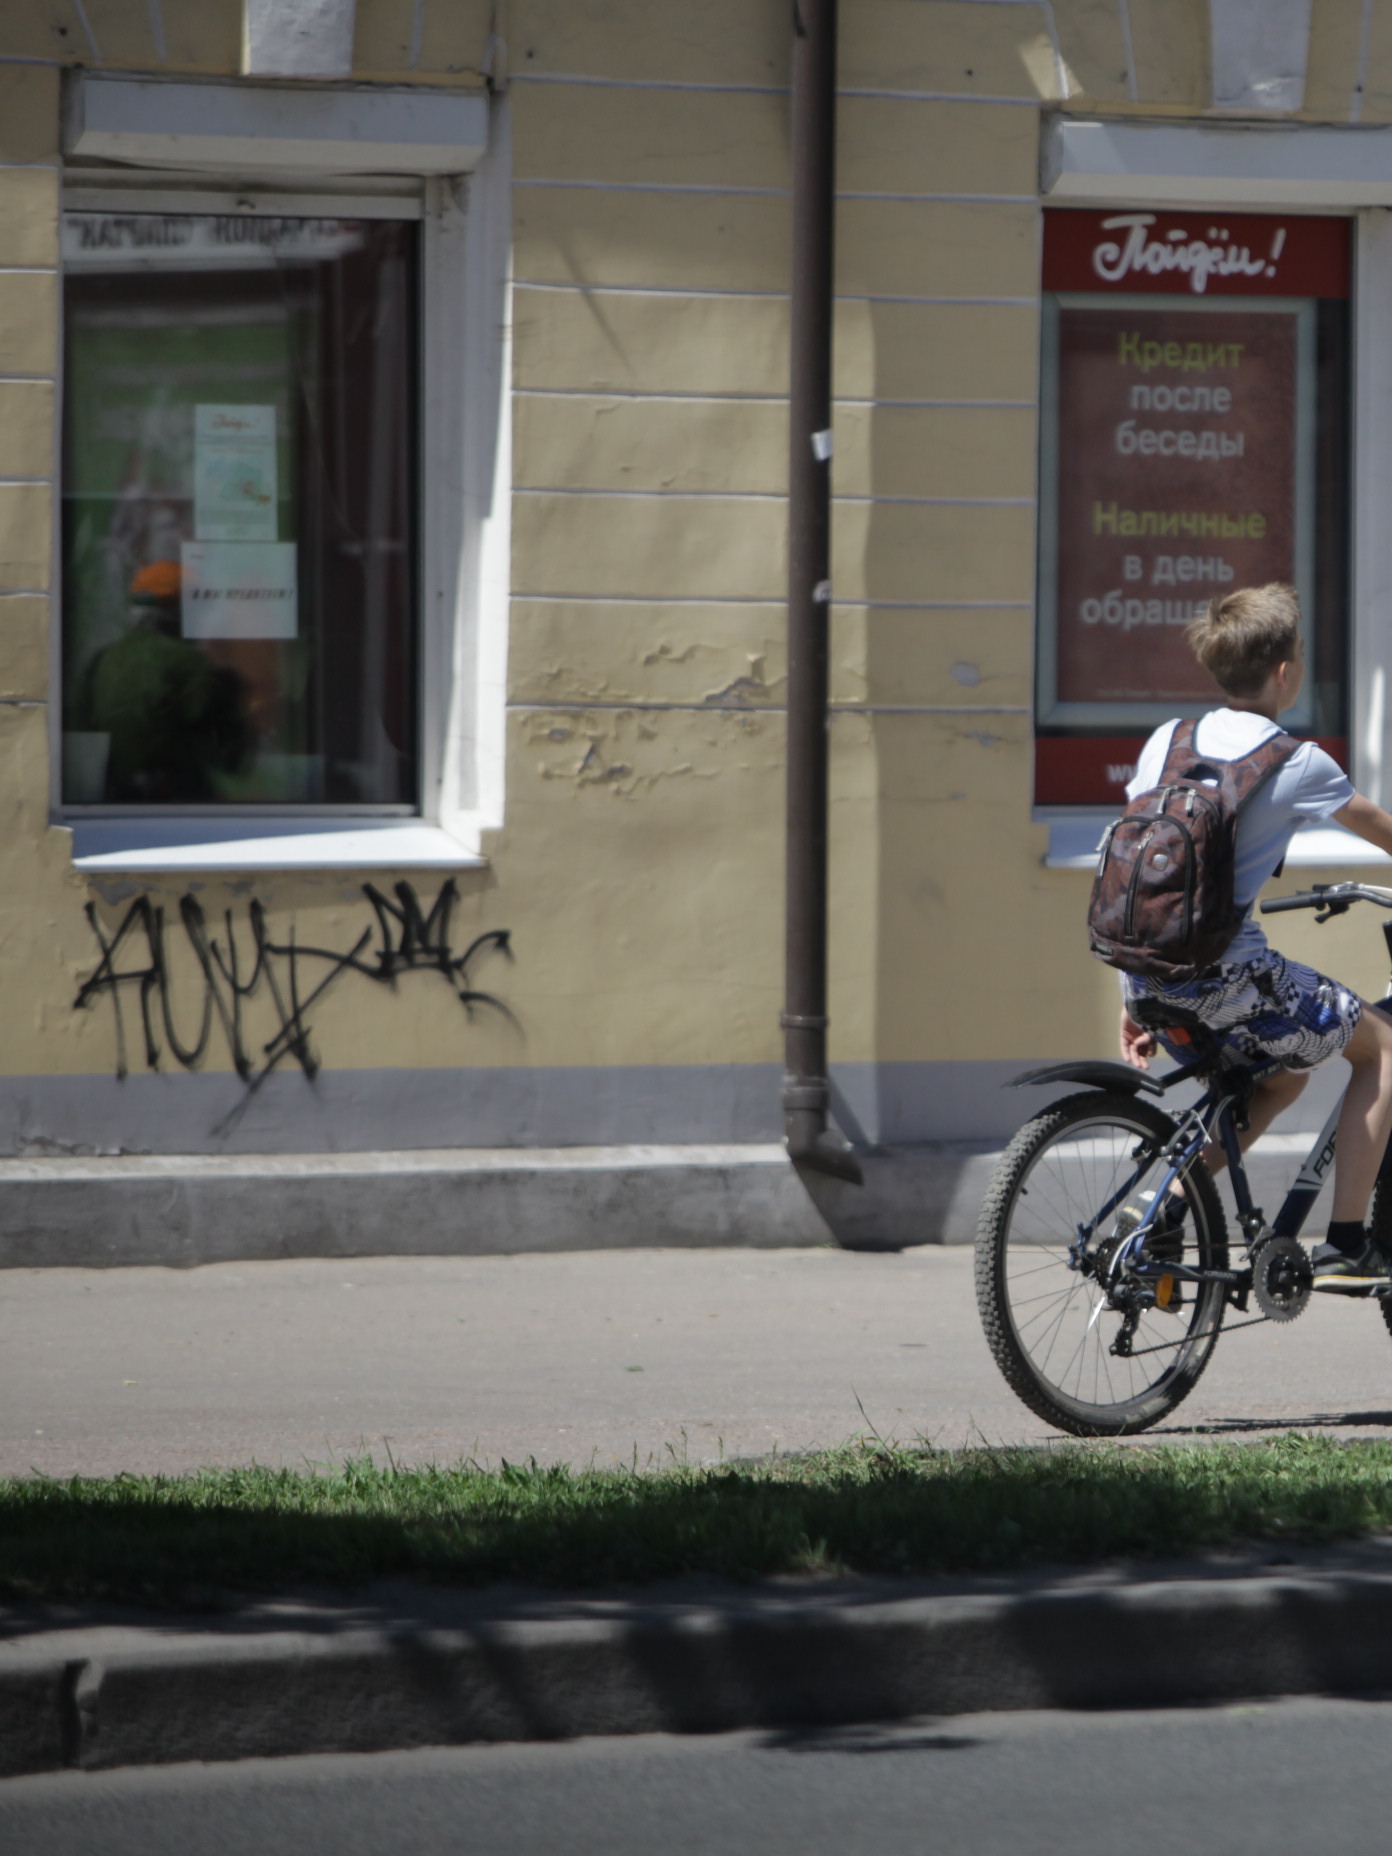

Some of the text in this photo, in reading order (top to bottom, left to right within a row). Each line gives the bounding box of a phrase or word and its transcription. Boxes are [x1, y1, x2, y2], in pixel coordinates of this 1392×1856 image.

[1118, 332, 1244, 371] Кредит
[1130, 383, 1232, 413] после
[1114, 419, 1244, 459] беседы
[1093, 502, 1267, 539] Наличные
[1123, 554, 1235, 585] в день
